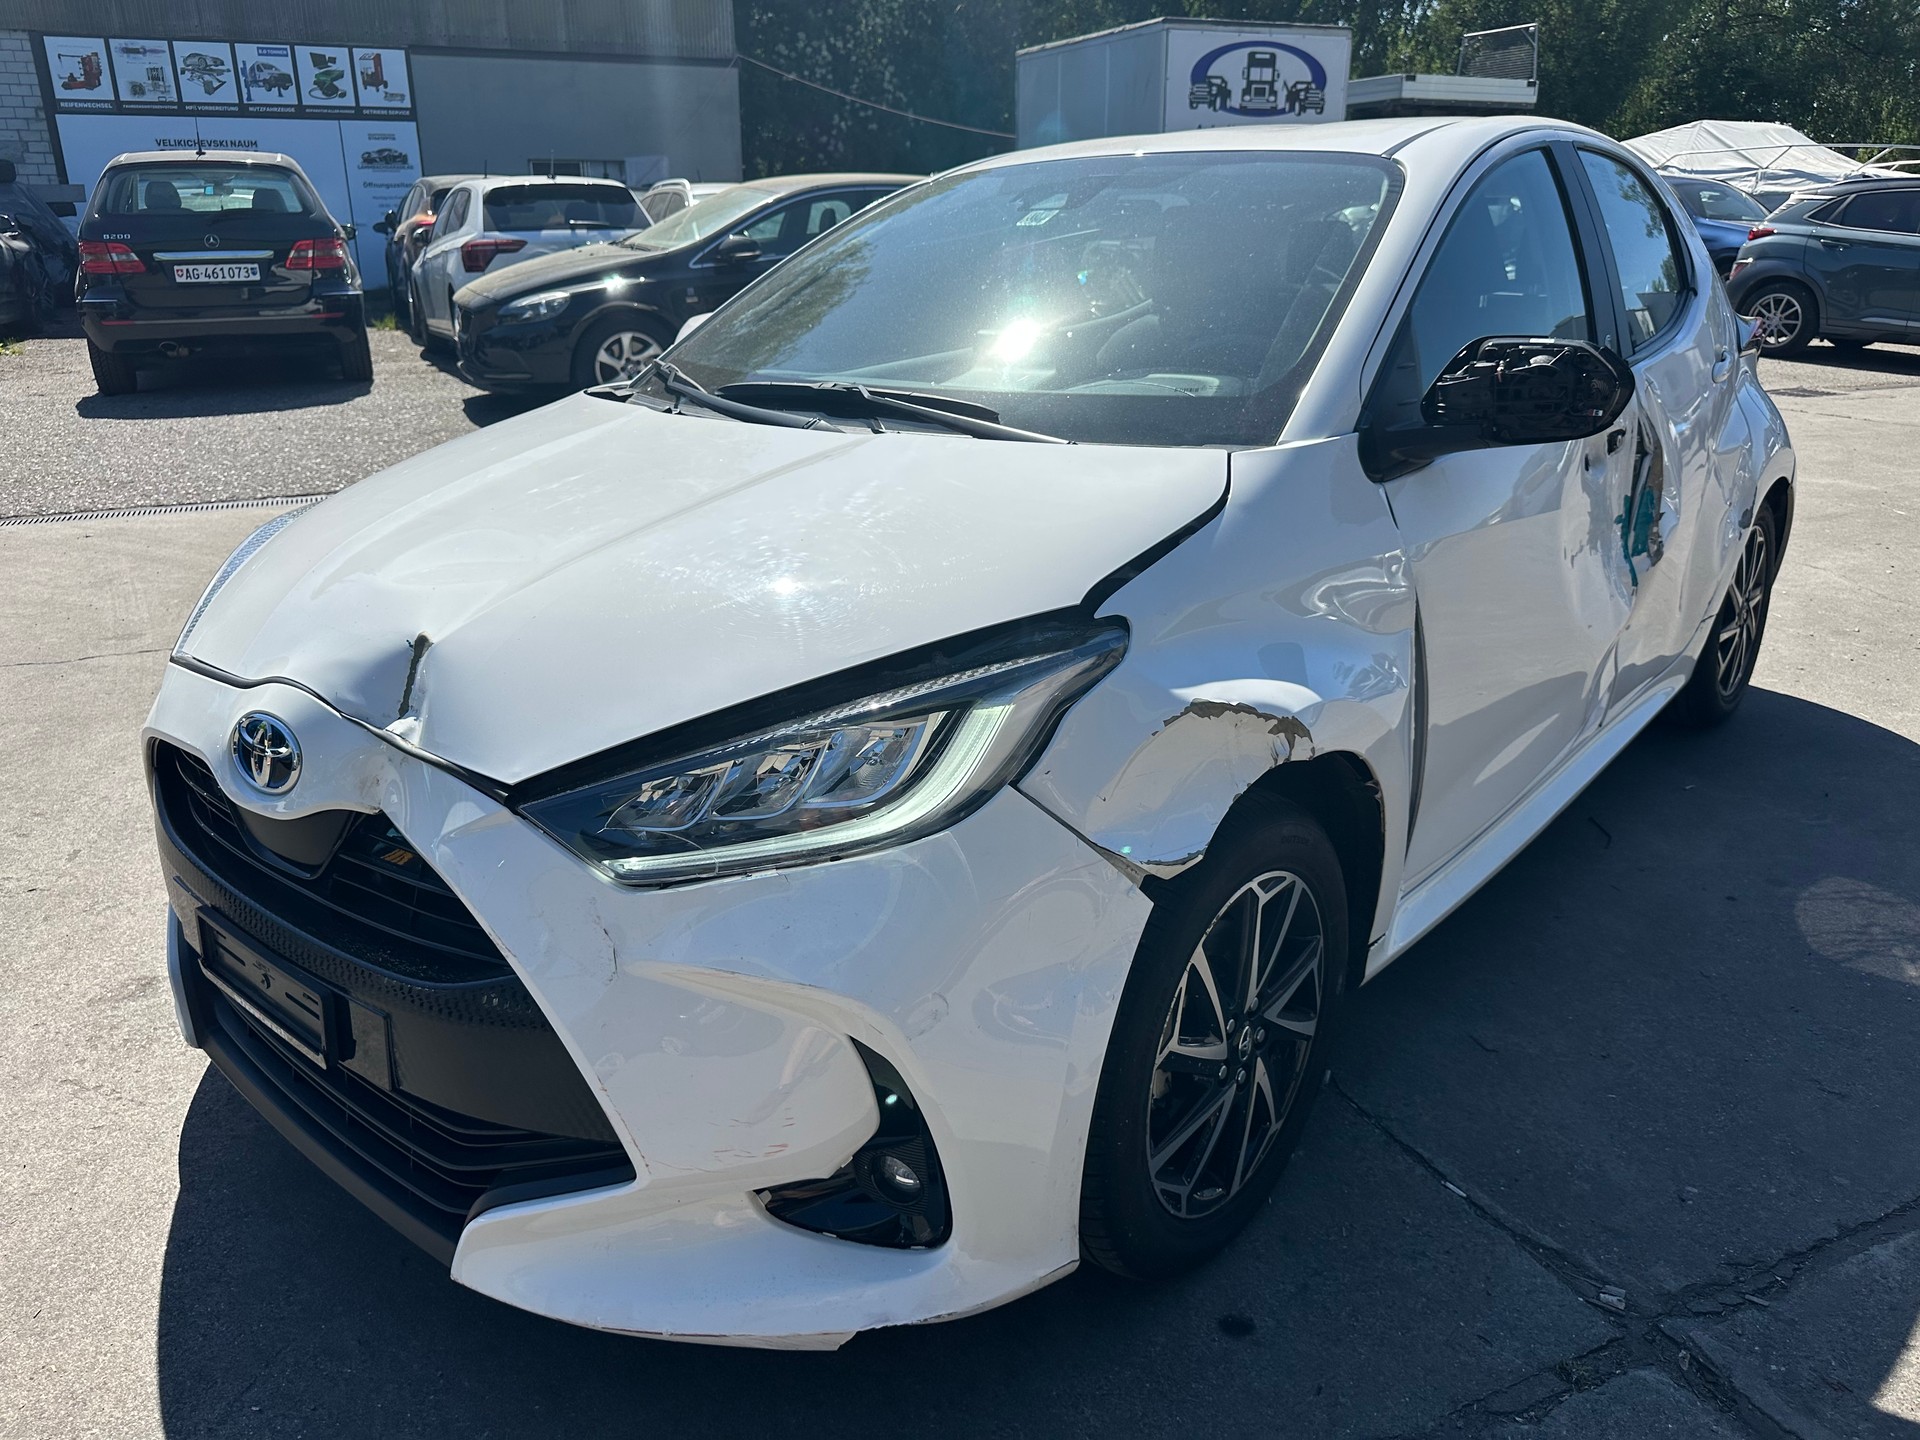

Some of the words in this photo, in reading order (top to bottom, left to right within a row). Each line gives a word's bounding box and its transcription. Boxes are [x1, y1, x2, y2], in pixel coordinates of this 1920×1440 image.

[60, 101, 113, 109] REIFENWECHSEL
[154, 138, 228, 147] VELIKICHEVSKI
[230, 139, 258, 148] NAUM
